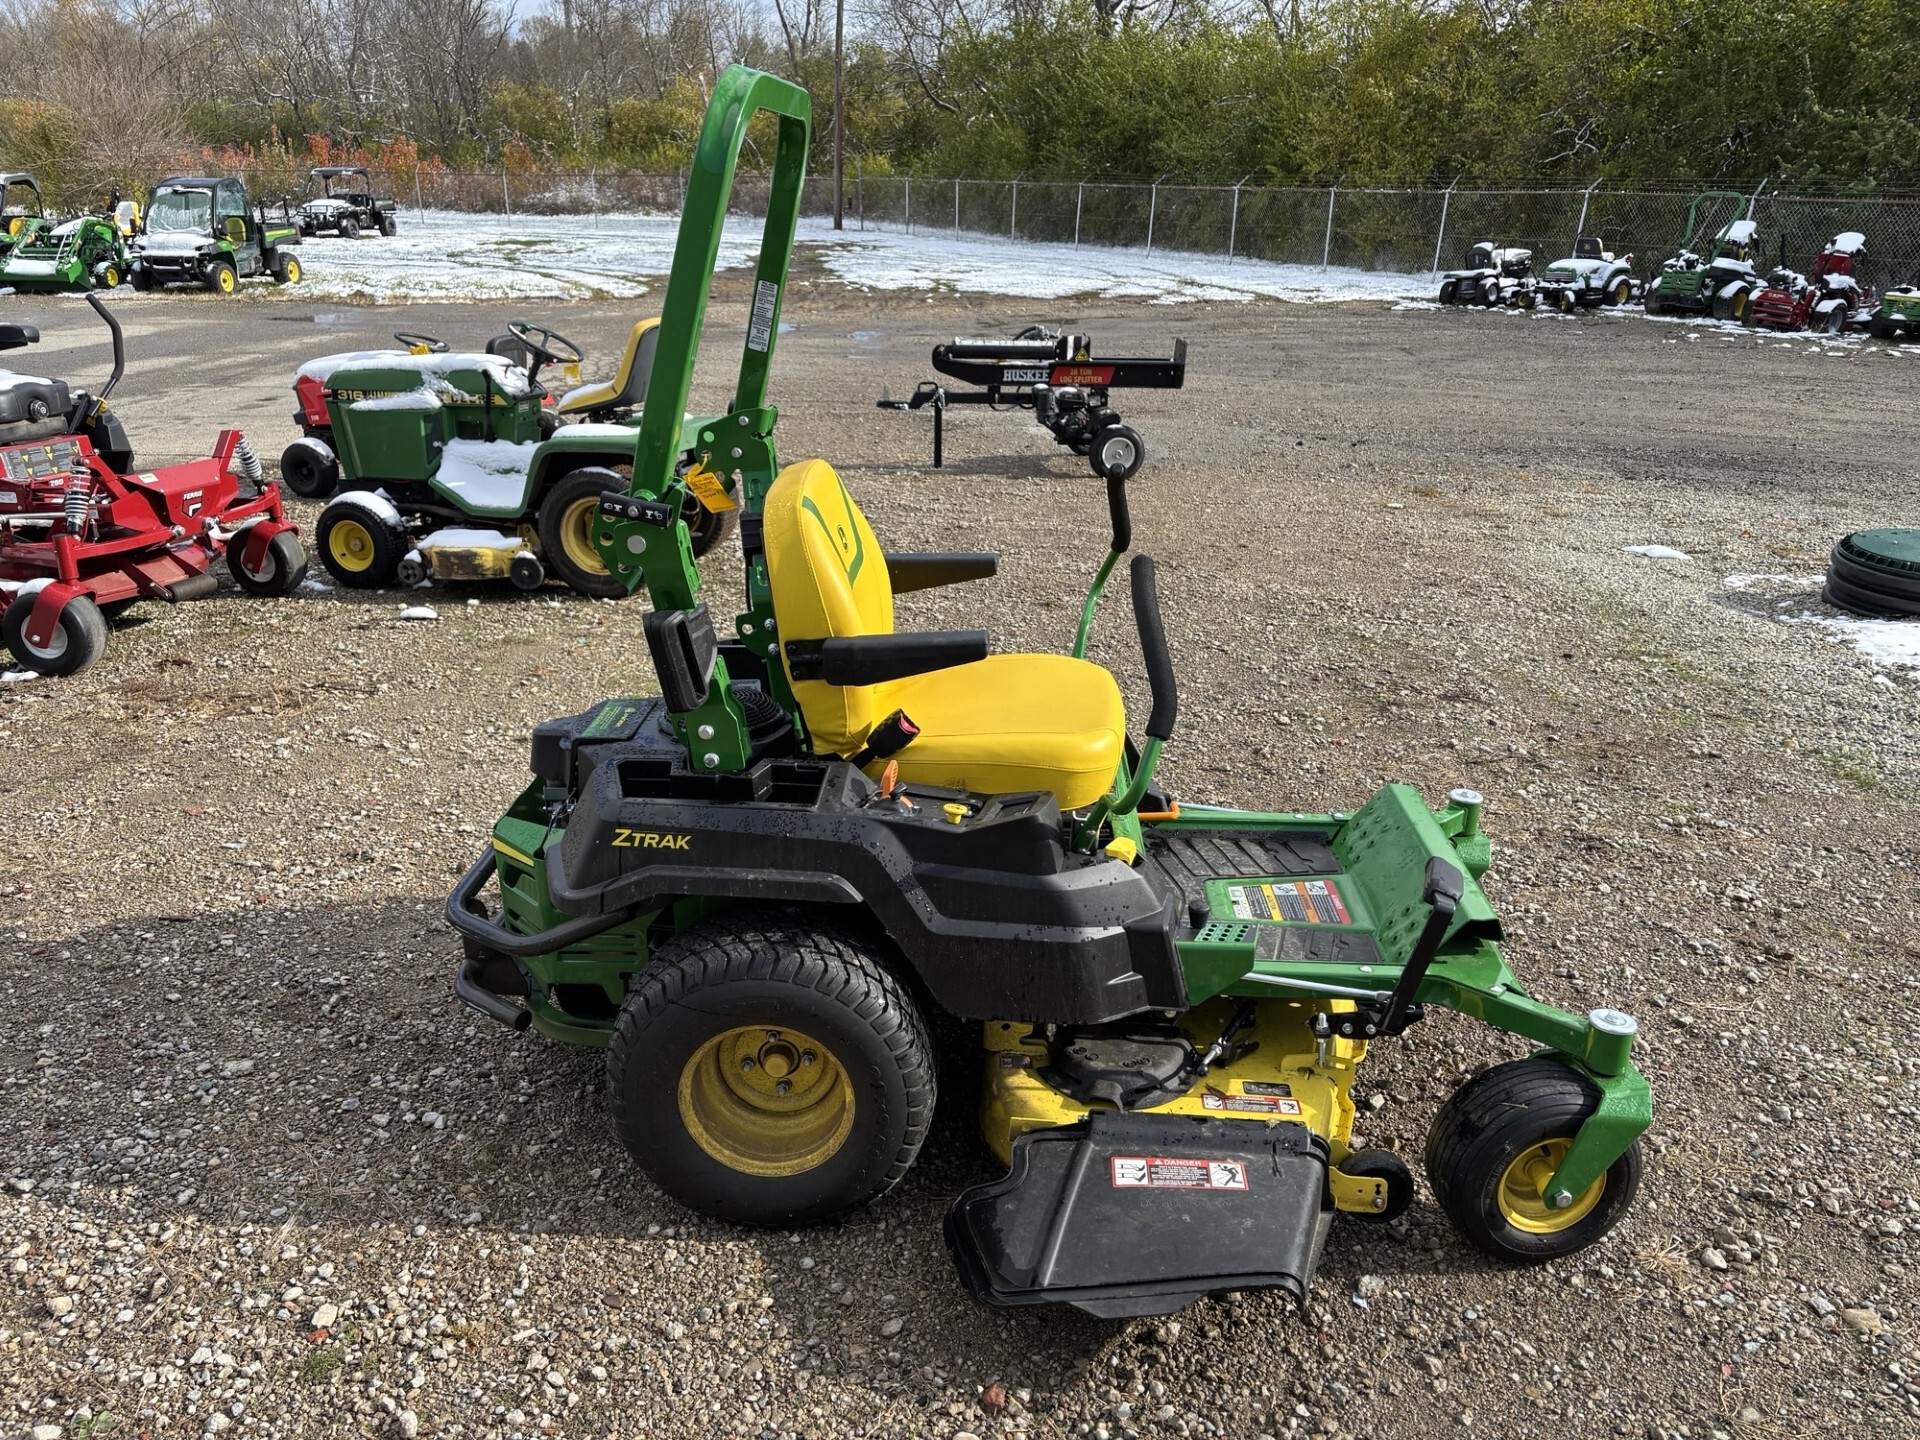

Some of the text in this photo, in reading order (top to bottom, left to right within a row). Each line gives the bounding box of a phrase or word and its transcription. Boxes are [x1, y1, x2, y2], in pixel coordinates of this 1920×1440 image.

[1003, 369, 1050, 382] HUSKEE
[337, 390, 363, 400] 316
[611, 828, 692, 850] ZTRAK
[1164, 1159, 1201, 1167] DANGER
